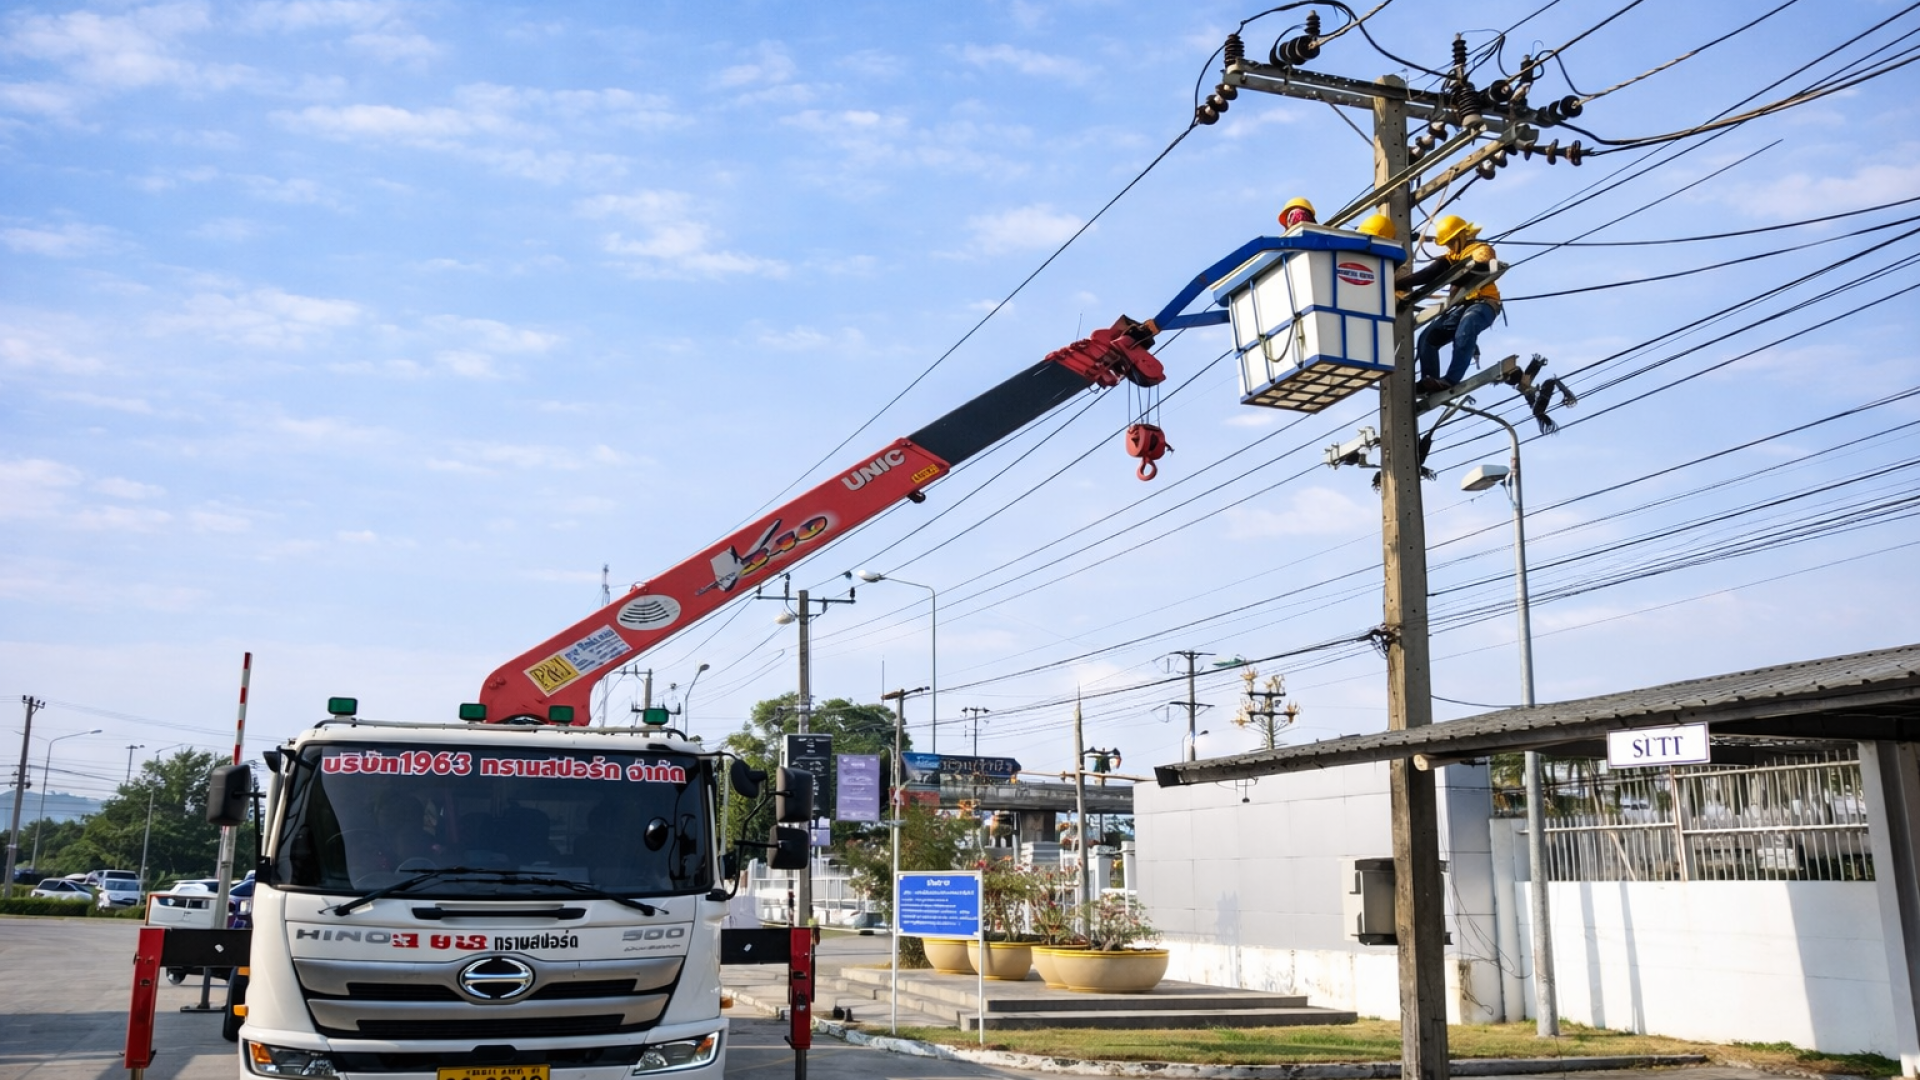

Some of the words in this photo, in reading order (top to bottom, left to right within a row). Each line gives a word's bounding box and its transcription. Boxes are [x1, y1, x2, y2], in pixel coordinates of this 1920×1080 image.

[841, 449, 905, 491] UNIC
[296, 929, 391, 944] HINO
[622, 927, 684, 941] 500
